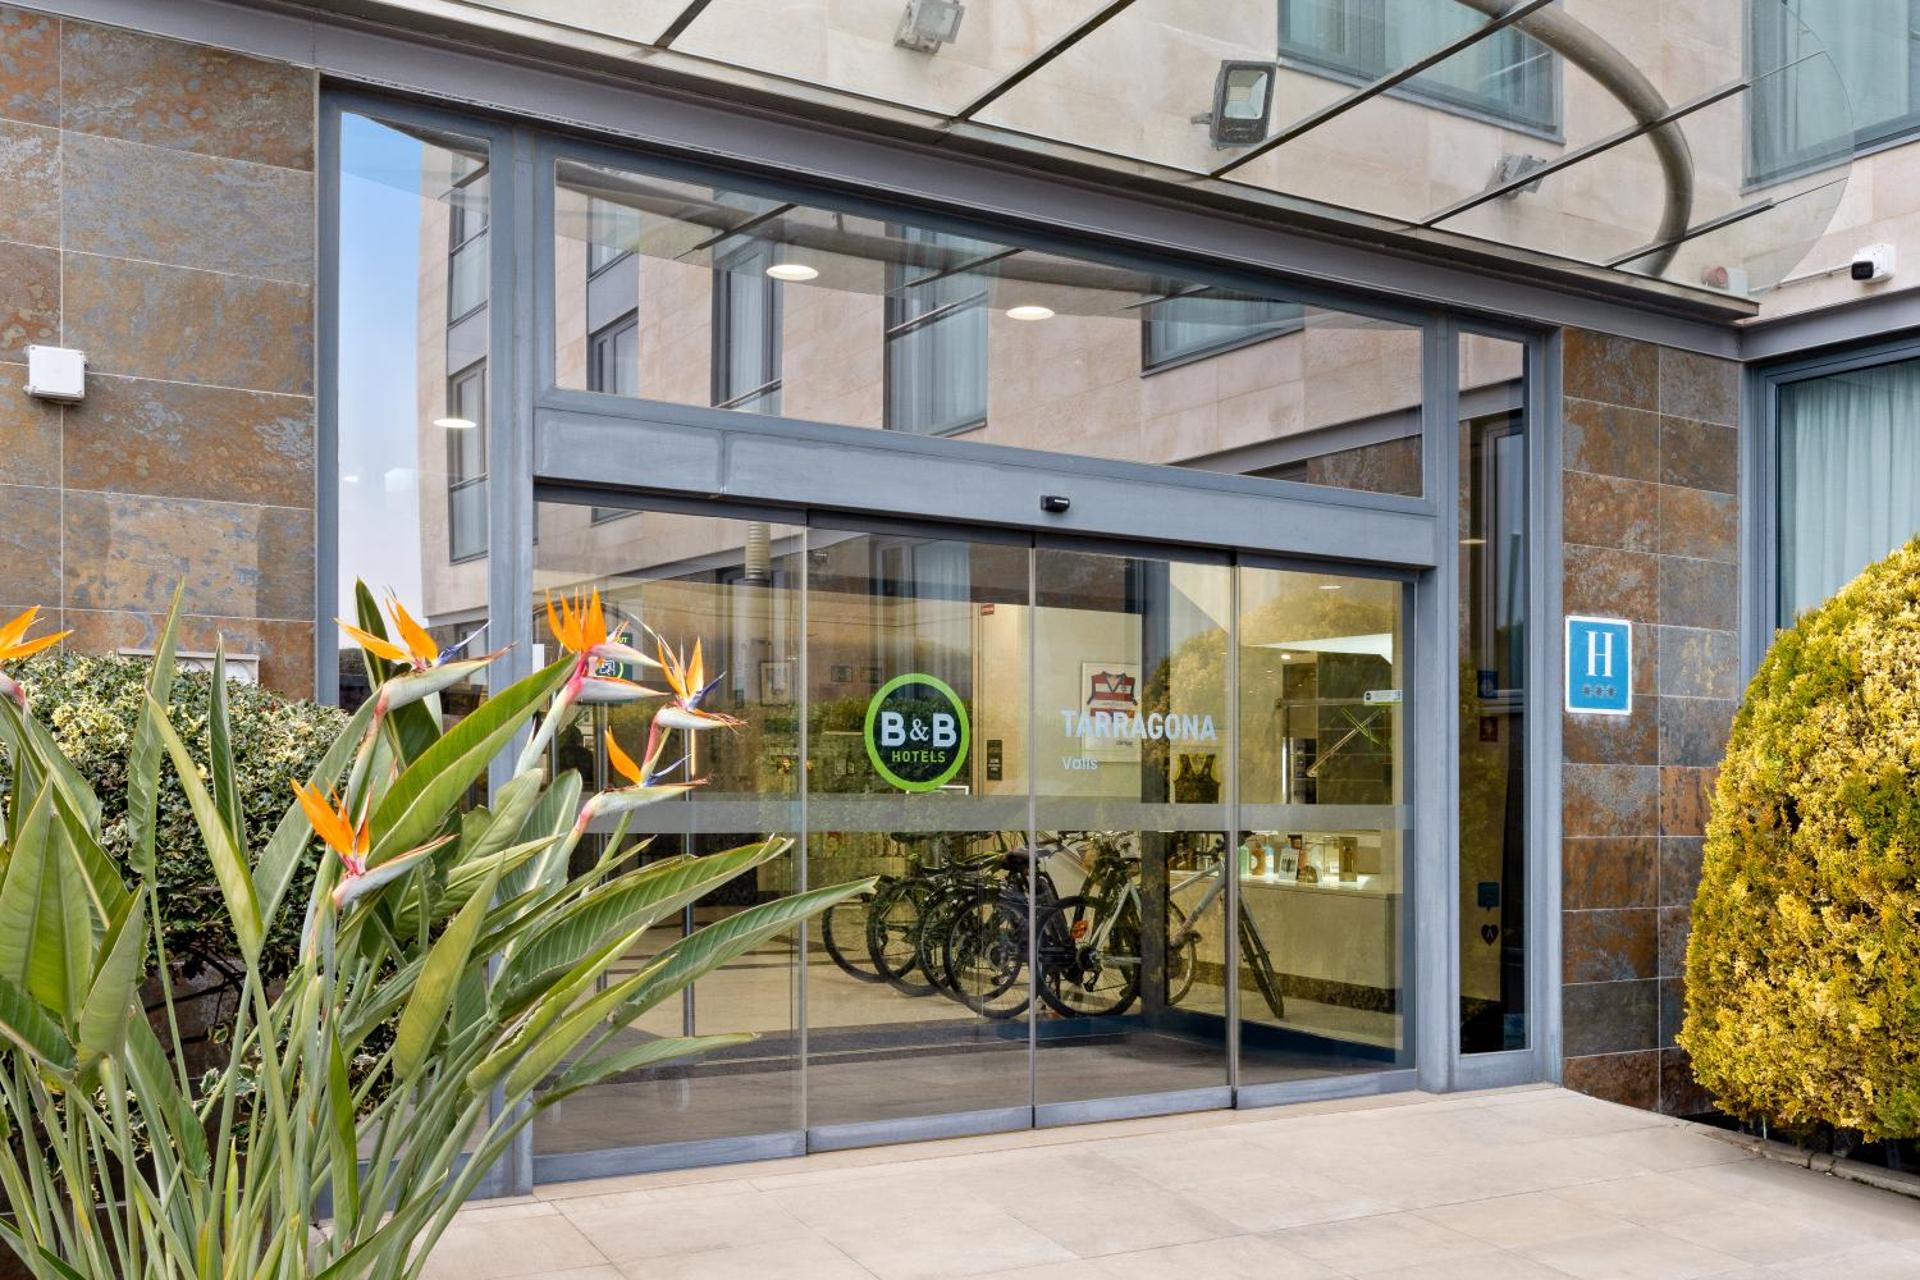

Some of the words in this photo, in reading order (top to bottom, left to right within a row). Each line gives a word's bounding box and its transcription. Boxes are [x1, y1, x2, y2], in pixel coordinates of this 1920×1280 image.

[1585, 630, 1615, 677] H
[881, 711, 957, 748] B&B
[1061, 709, 1217, 741] TARRAGONA
[891, 750, 946, 763] HOTELS
[1062, 756, 1099, 770] Valls
